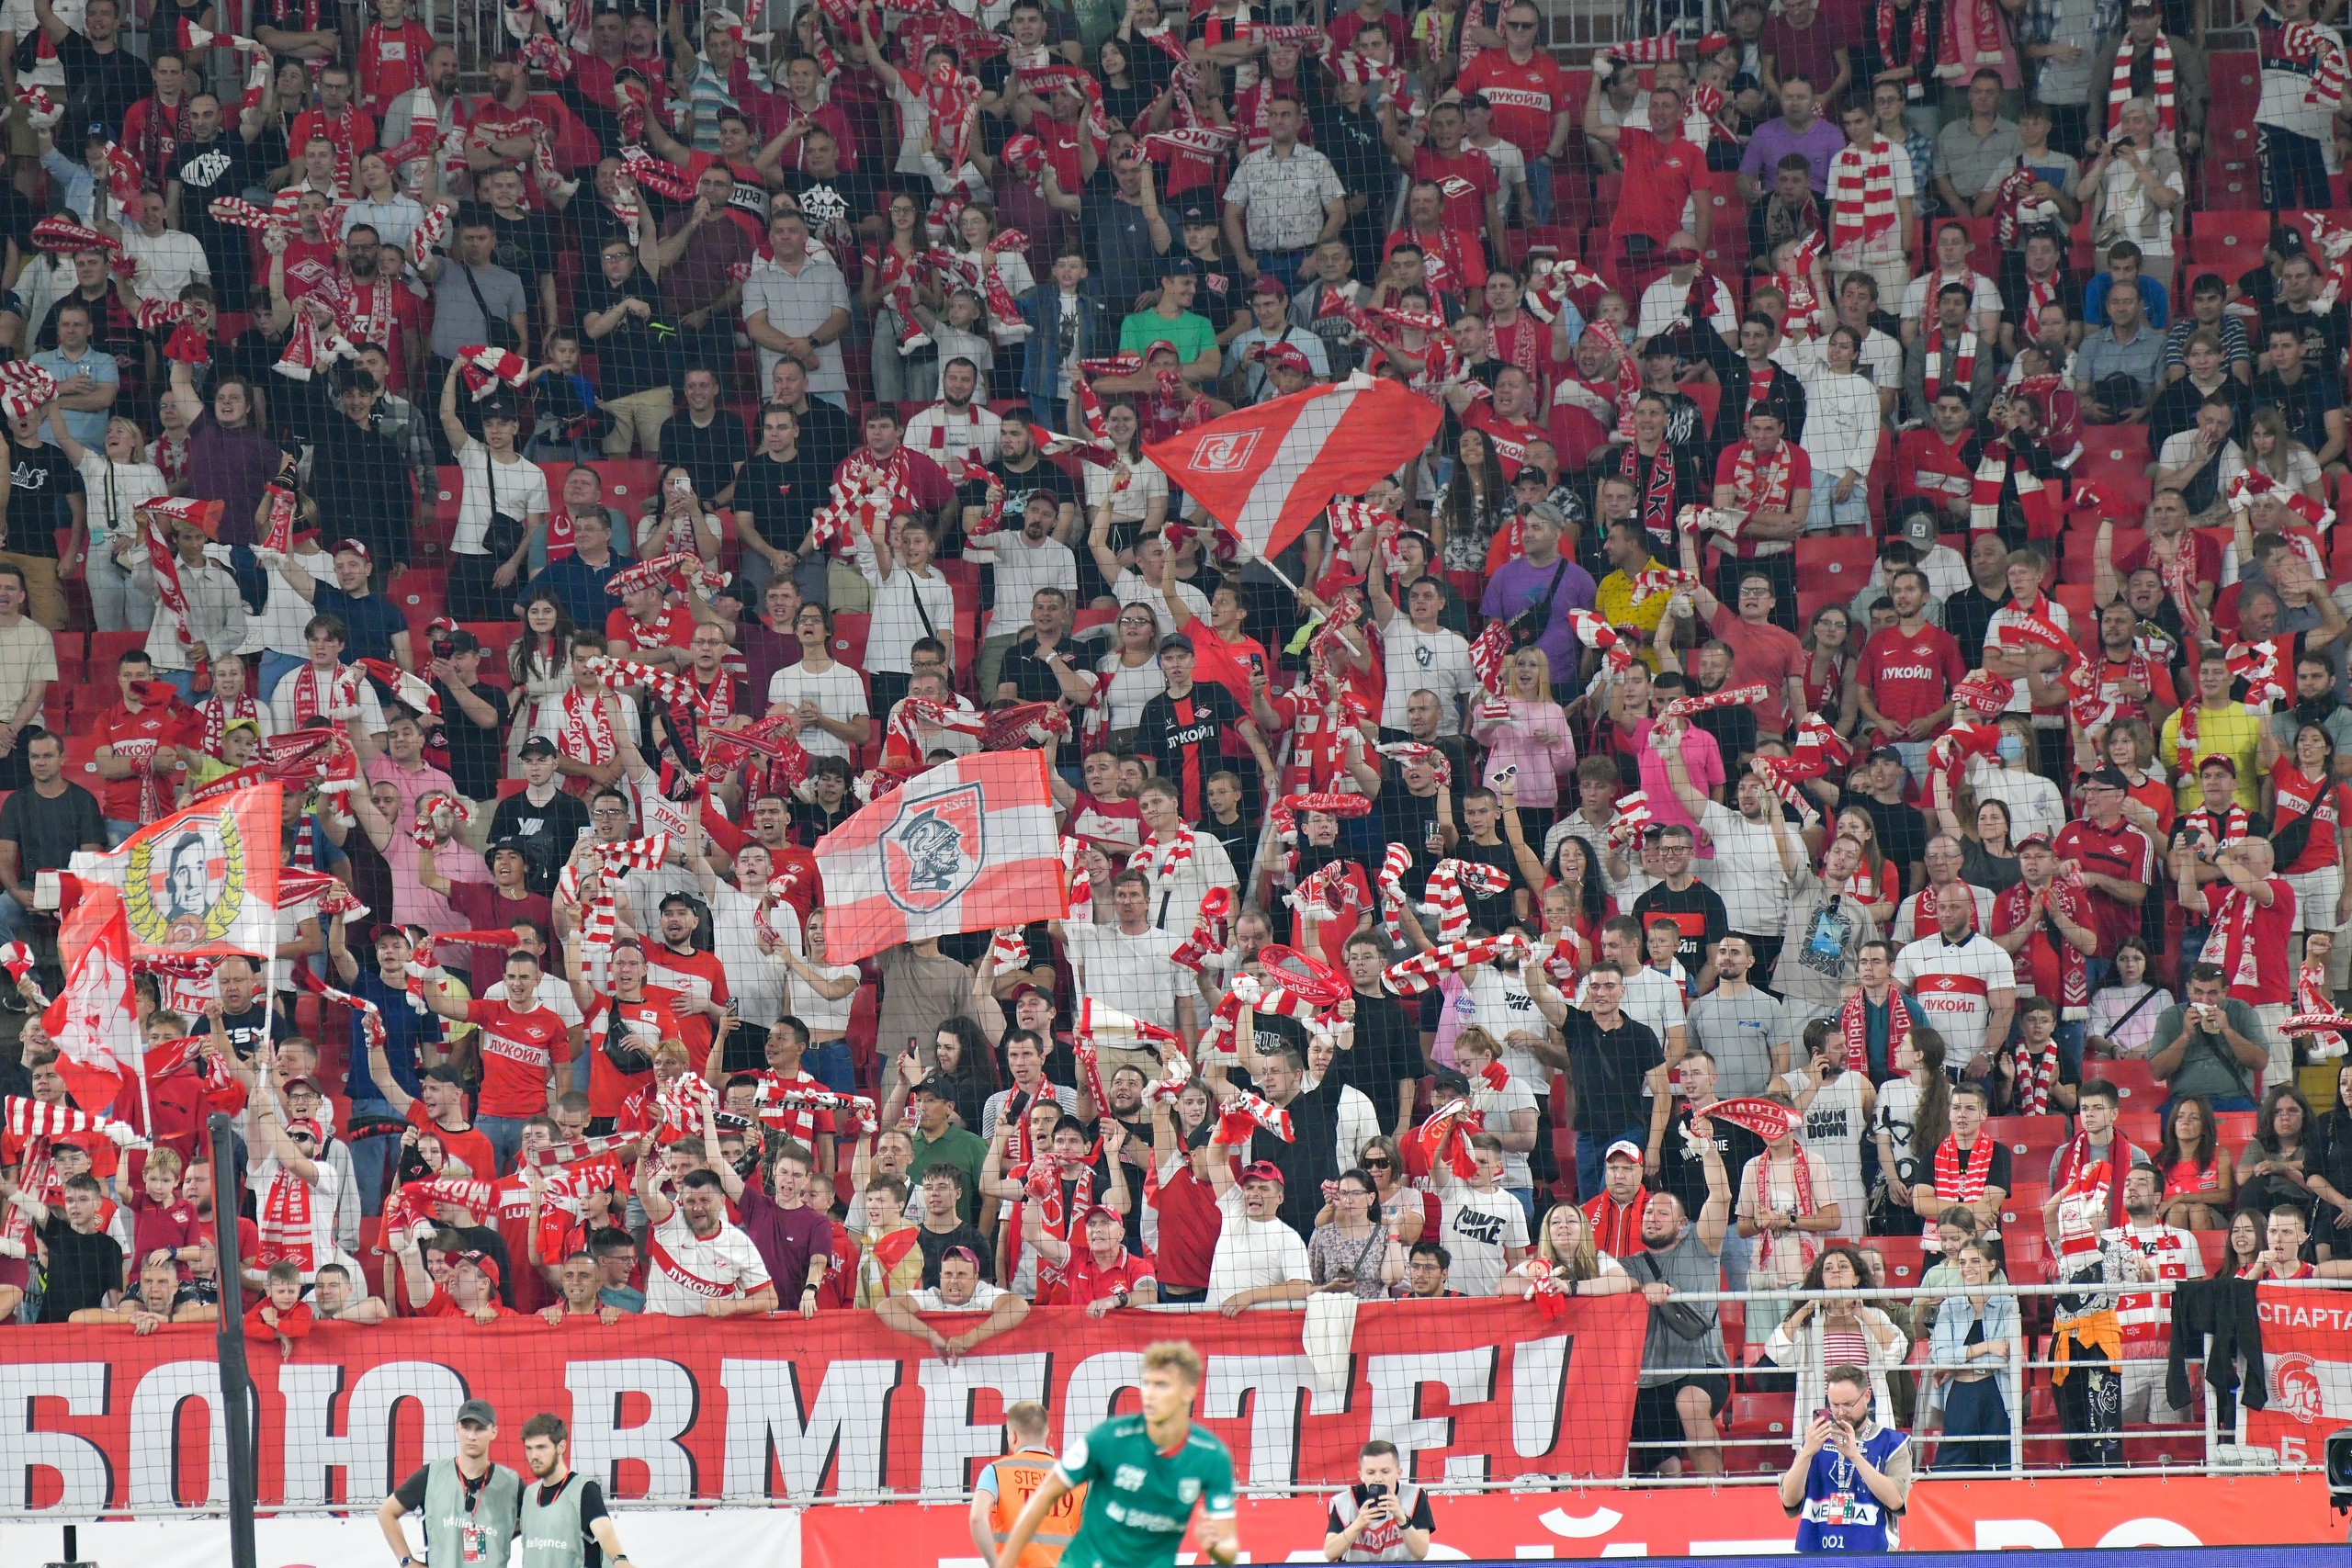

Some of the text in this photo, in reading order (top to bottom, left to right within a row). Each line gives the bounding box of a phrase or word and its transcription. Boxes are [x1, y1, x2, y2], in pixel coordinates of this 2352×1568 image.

[1488, 92, 1543, 107] ЛУКОЙЛ
[732, 187, 762, 204] ppa
[1882, 665, 1932, 681] ЛУКОЙЛ
[115, 741, 157, 757] УКОЙ
[2289, 798, 2332, 819] ЛУКЙЛ
[654, 807, 687, 835] ЛУКО
[1923, 998, 1974, 1013] ЛУКОЙЛ
[489, 1041, 542, 1065] ЛУКОЙЛ
[1807, 1122, 1848, 1139] DOWN
[2140, 1242, 2157, 1256] IKE
[667, 1266, 725, 1297] ЛУКОЙЛ
[1014, 1470, 1047, 1486] STEW
[1811, 1506, 1869, 1522] MEIA
[526, 1539, 568, 1550] telligence
[1822, 1535, 1845, 1550] 001
